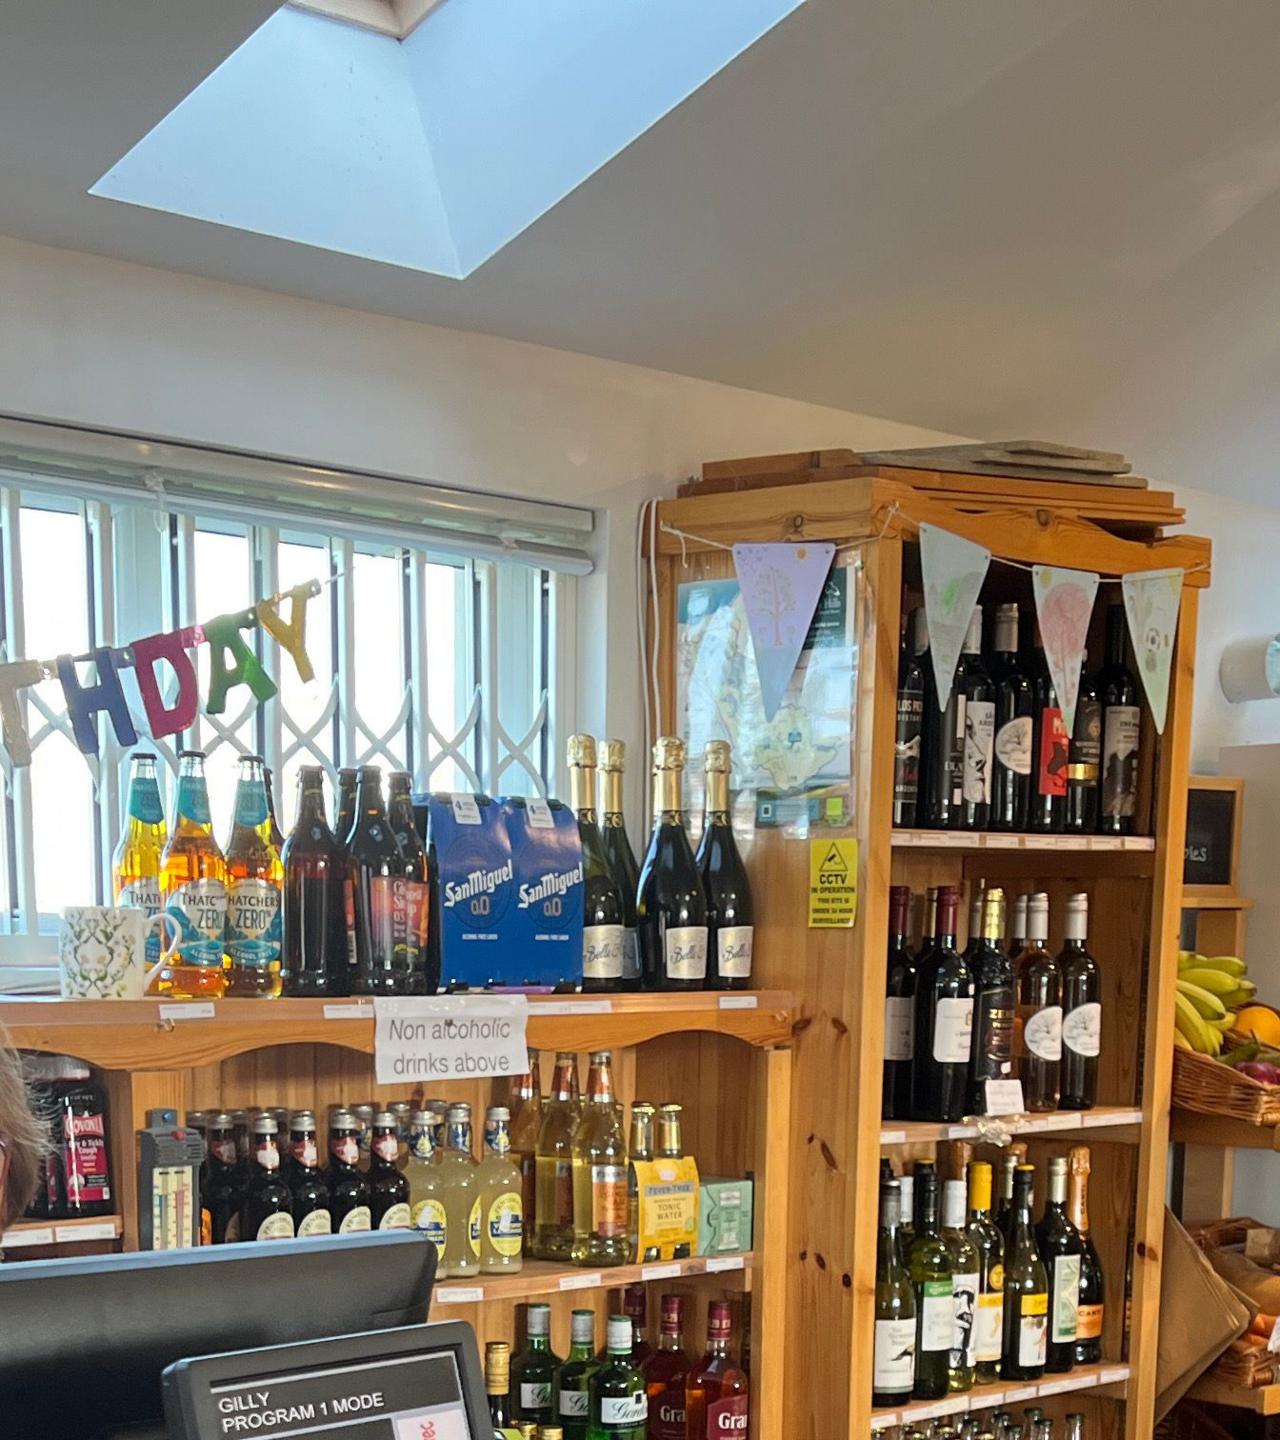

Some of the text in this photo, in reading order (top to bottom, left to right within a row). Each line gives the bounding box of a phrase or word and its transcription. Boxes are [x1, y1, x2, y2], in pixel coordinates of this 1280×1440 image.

[820, 874, 847, 885] CCTV
[388, 1016, 511, 1043] Non alcoholic
[393, 1052, 510, 1077] drinks above
[218, 1391, 271, 1414] GILLY
[222, 1392, 385, 1433] PROGRAM 1 MODE
